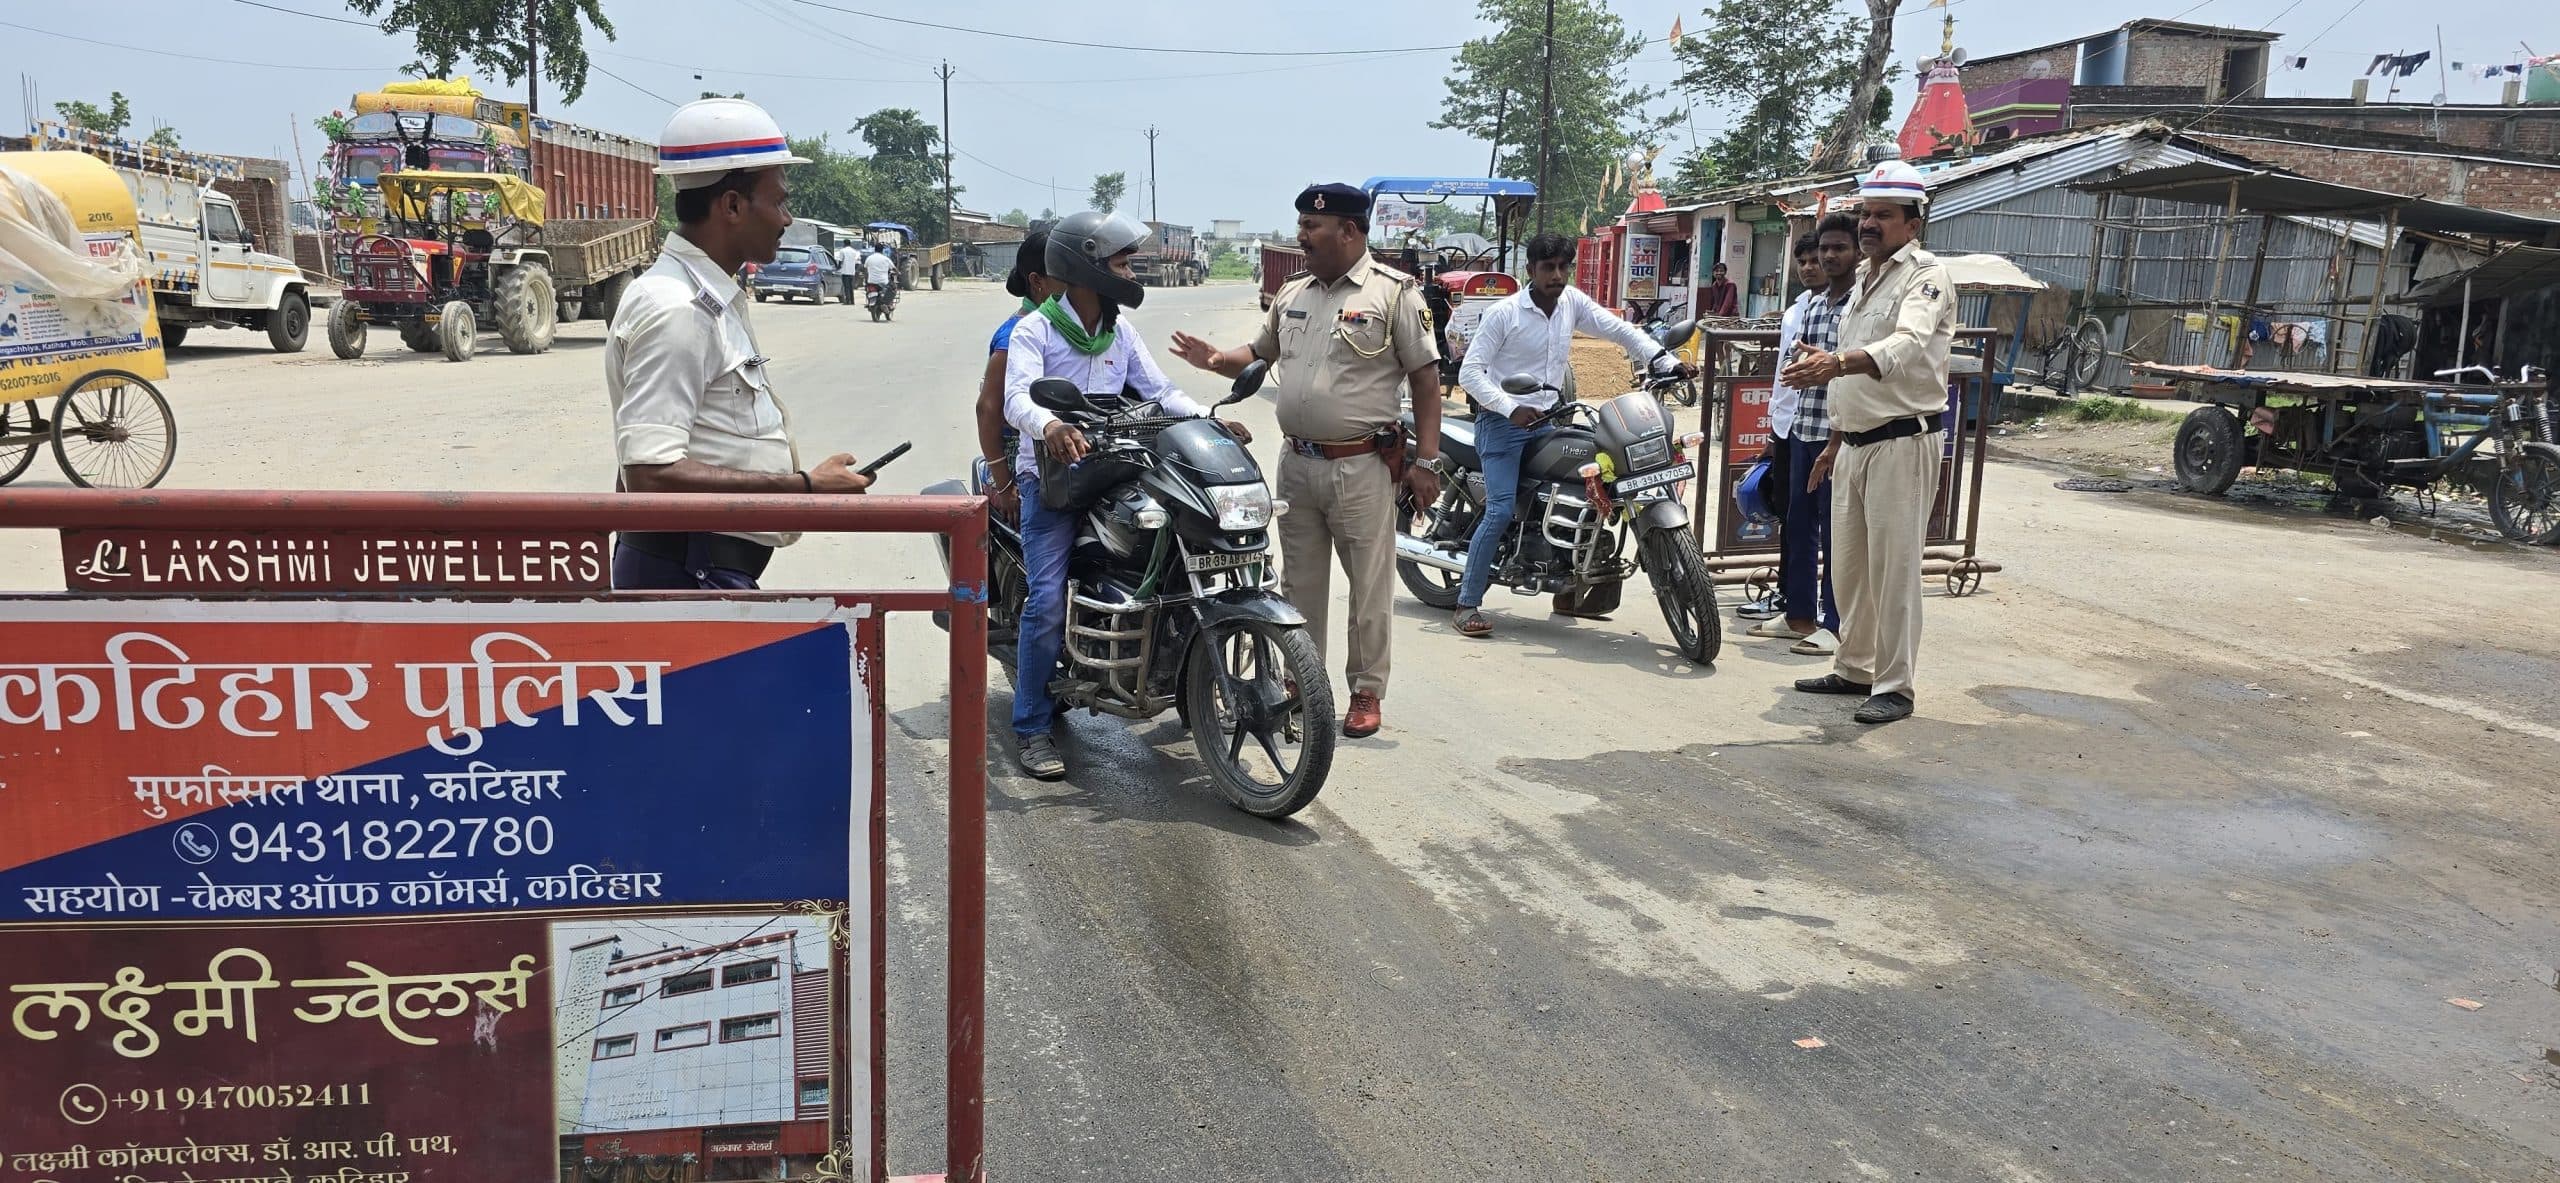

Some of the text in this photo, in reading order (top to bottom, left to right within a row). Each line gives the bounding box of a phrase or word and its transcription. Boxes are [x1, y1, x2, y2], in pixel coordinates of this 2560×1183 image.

[1876, 169, 1885, 179] P
[88, 213, 113, 223] 2016
[140, 539, 331, 582] LAKSHMI
[353, 540, 600, 582] JEWELLERS
[0, 632, 671, 755] कटिहार पुलिस
[128, 764, 306, 819] मुफस्सिल
[423, 761, 567, 805] कटिहार
[229, 815, 554, 863] 9431822780
[22, 872, 161, 914] सहयोग
[289, 874, 380, 909] ऑफ
[526, 863, 663, 900] कटिहार
[10, 947, 536, 1058] लक्ष्मी ज्वेलर्स
[111, 1083, 372, 1112] +91 9470052411
[11, 1144, 91, 1173] लक्ष्मी
[261, 1137, 297, 1162] डॉ.
[303, 1141, 359, 1160] आर.
[364, 1132, 401, 1158] पी.
[408, 1135, 458, 1156] पथ,
